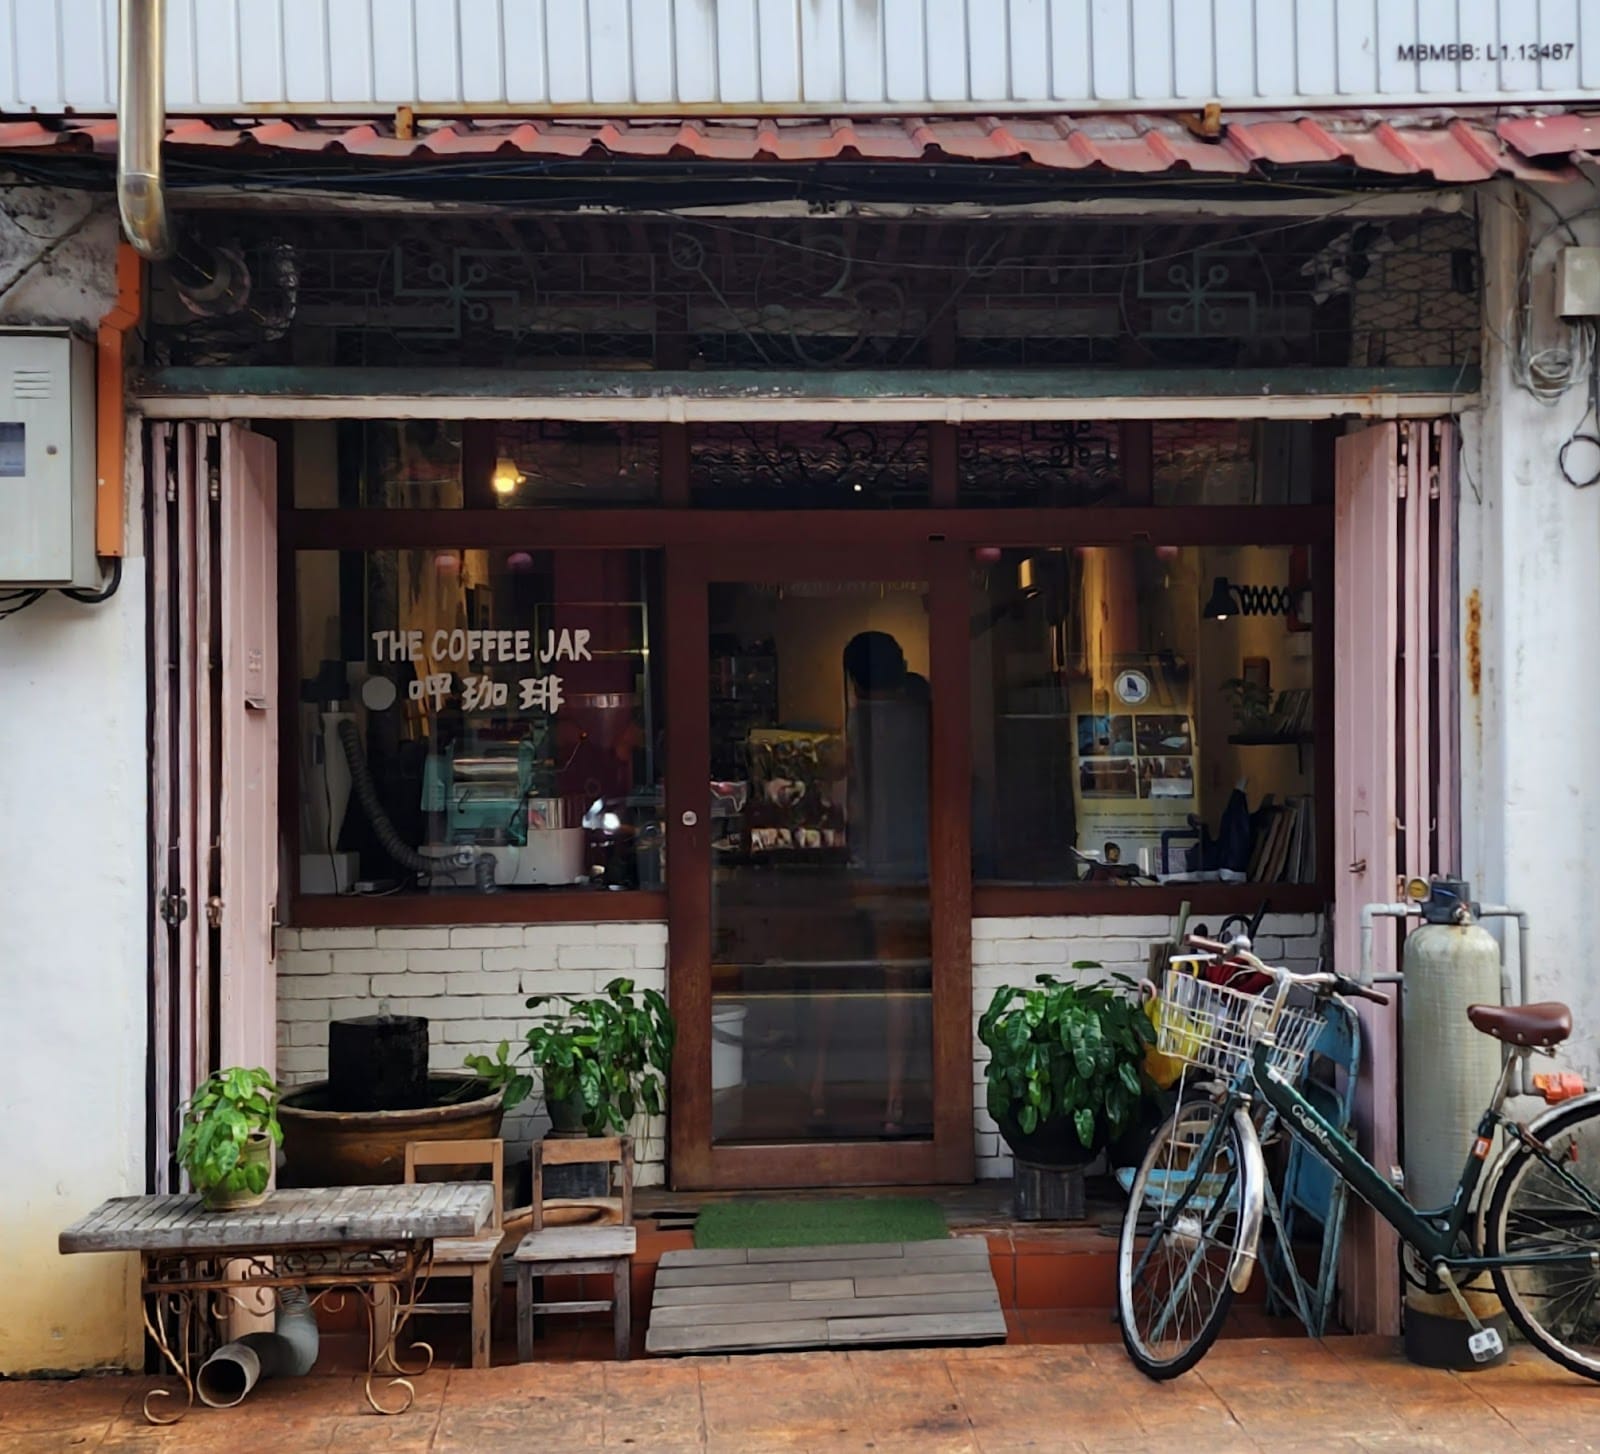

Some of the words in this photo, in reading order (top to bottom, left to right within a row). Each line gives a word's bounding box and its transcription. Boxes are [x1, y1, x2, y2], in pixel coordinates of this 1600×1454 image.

[1398, 44, 1480, 62] MBMBB:
[372, 630, 423, 661] THE
[432, 628, 531, 662] COFFEE
[540, 628, 592, 663] JAR
